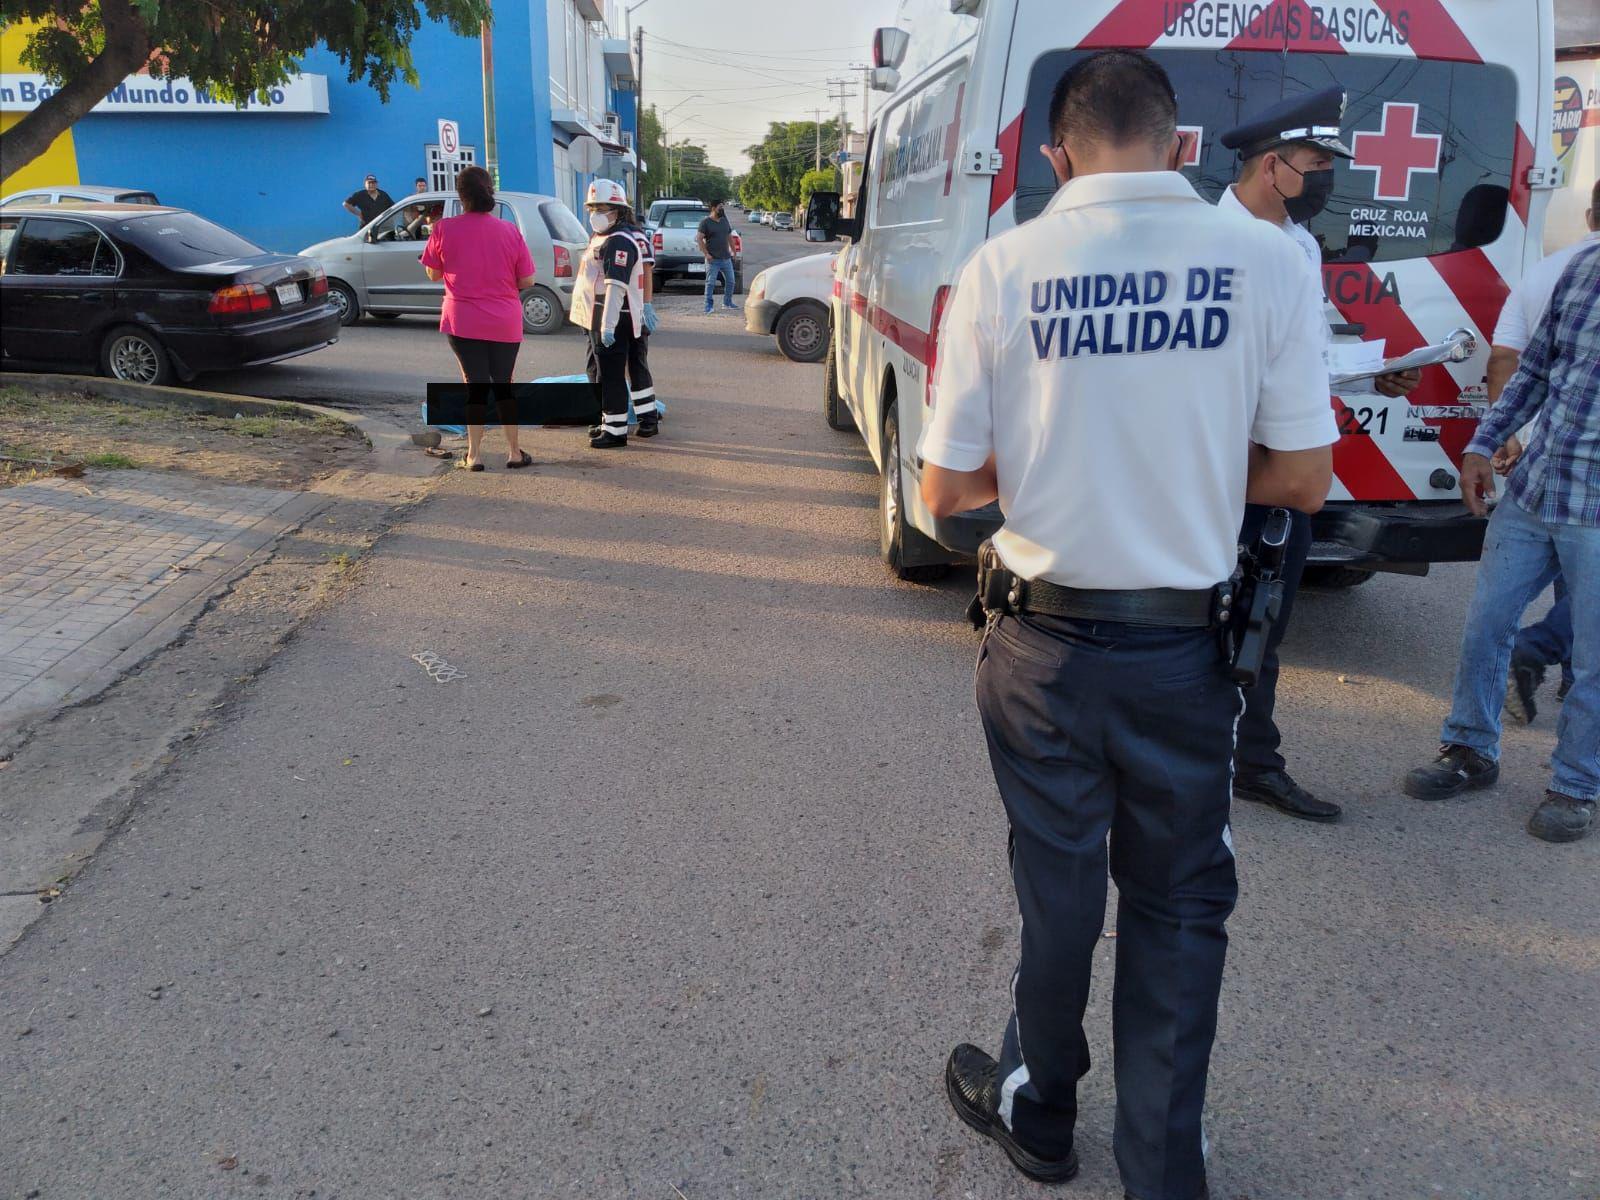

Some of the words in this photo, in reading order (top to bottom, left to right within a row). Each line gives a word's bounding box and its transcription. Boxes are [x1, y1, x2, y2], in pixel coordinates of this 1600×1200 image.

[1164, 2, 1302, 40] URGENCIAS
[1310, 6, 1409, 45] BASICAS
[106, 79, 189, 104] Mundo
[1349, 224, 1427, 238] MEXICANA
[1350, 208, 1387, 221] CRUZ
[1393, 209, 1429, 222] ROJA
[1030, 270, 1168, 314] UNIDAD
[1186, 266, 1236, 301] DE
[1030, 306, 1230, 361] VIALIDAD
